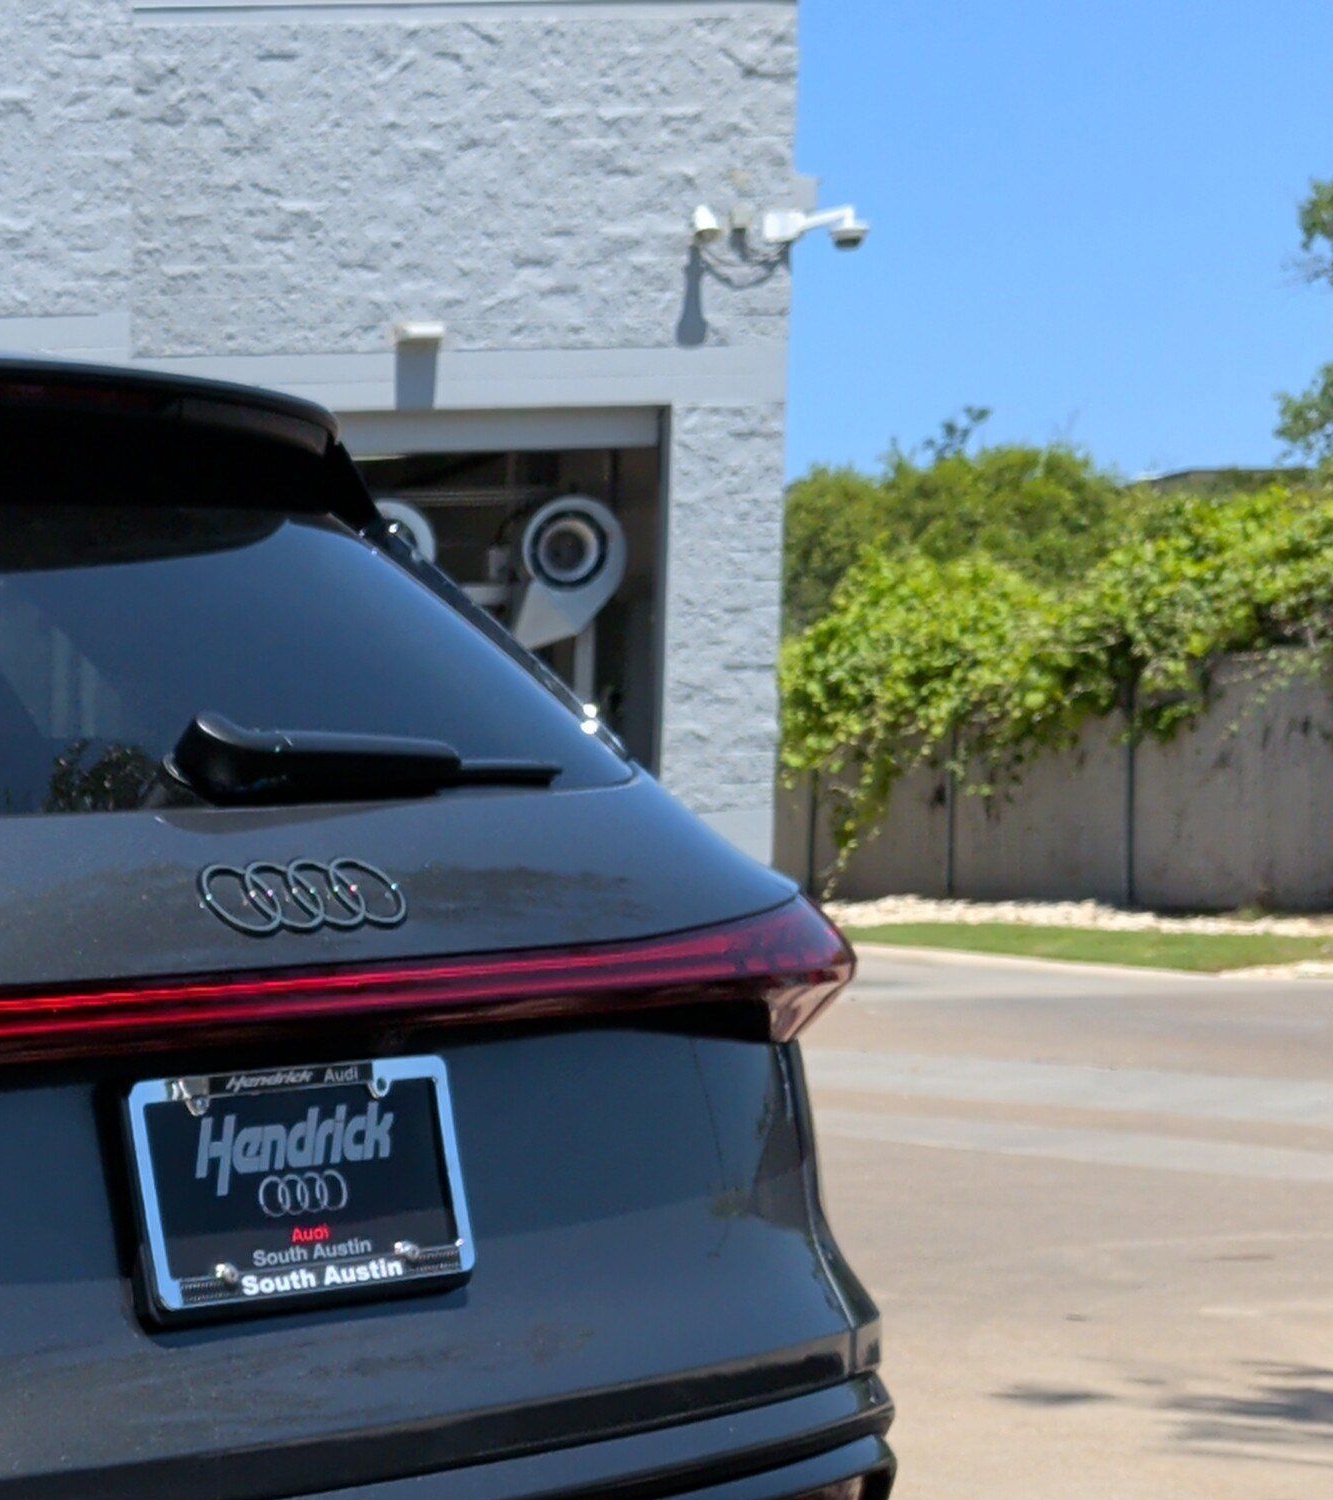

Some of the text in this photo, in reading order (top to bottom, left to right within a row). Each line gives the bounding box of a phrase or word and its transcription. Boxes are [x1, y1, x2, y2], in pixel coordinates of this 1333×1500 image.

[226, 1065, 359, 1093] Hendrick Audi
[195, 1100, 394, 1196] Hendrick
[291, 1222, 331, 1244] Audi
[252, 1237, 373, 1268] South Austin
[241, 1258, 404, 1296] South Austin
